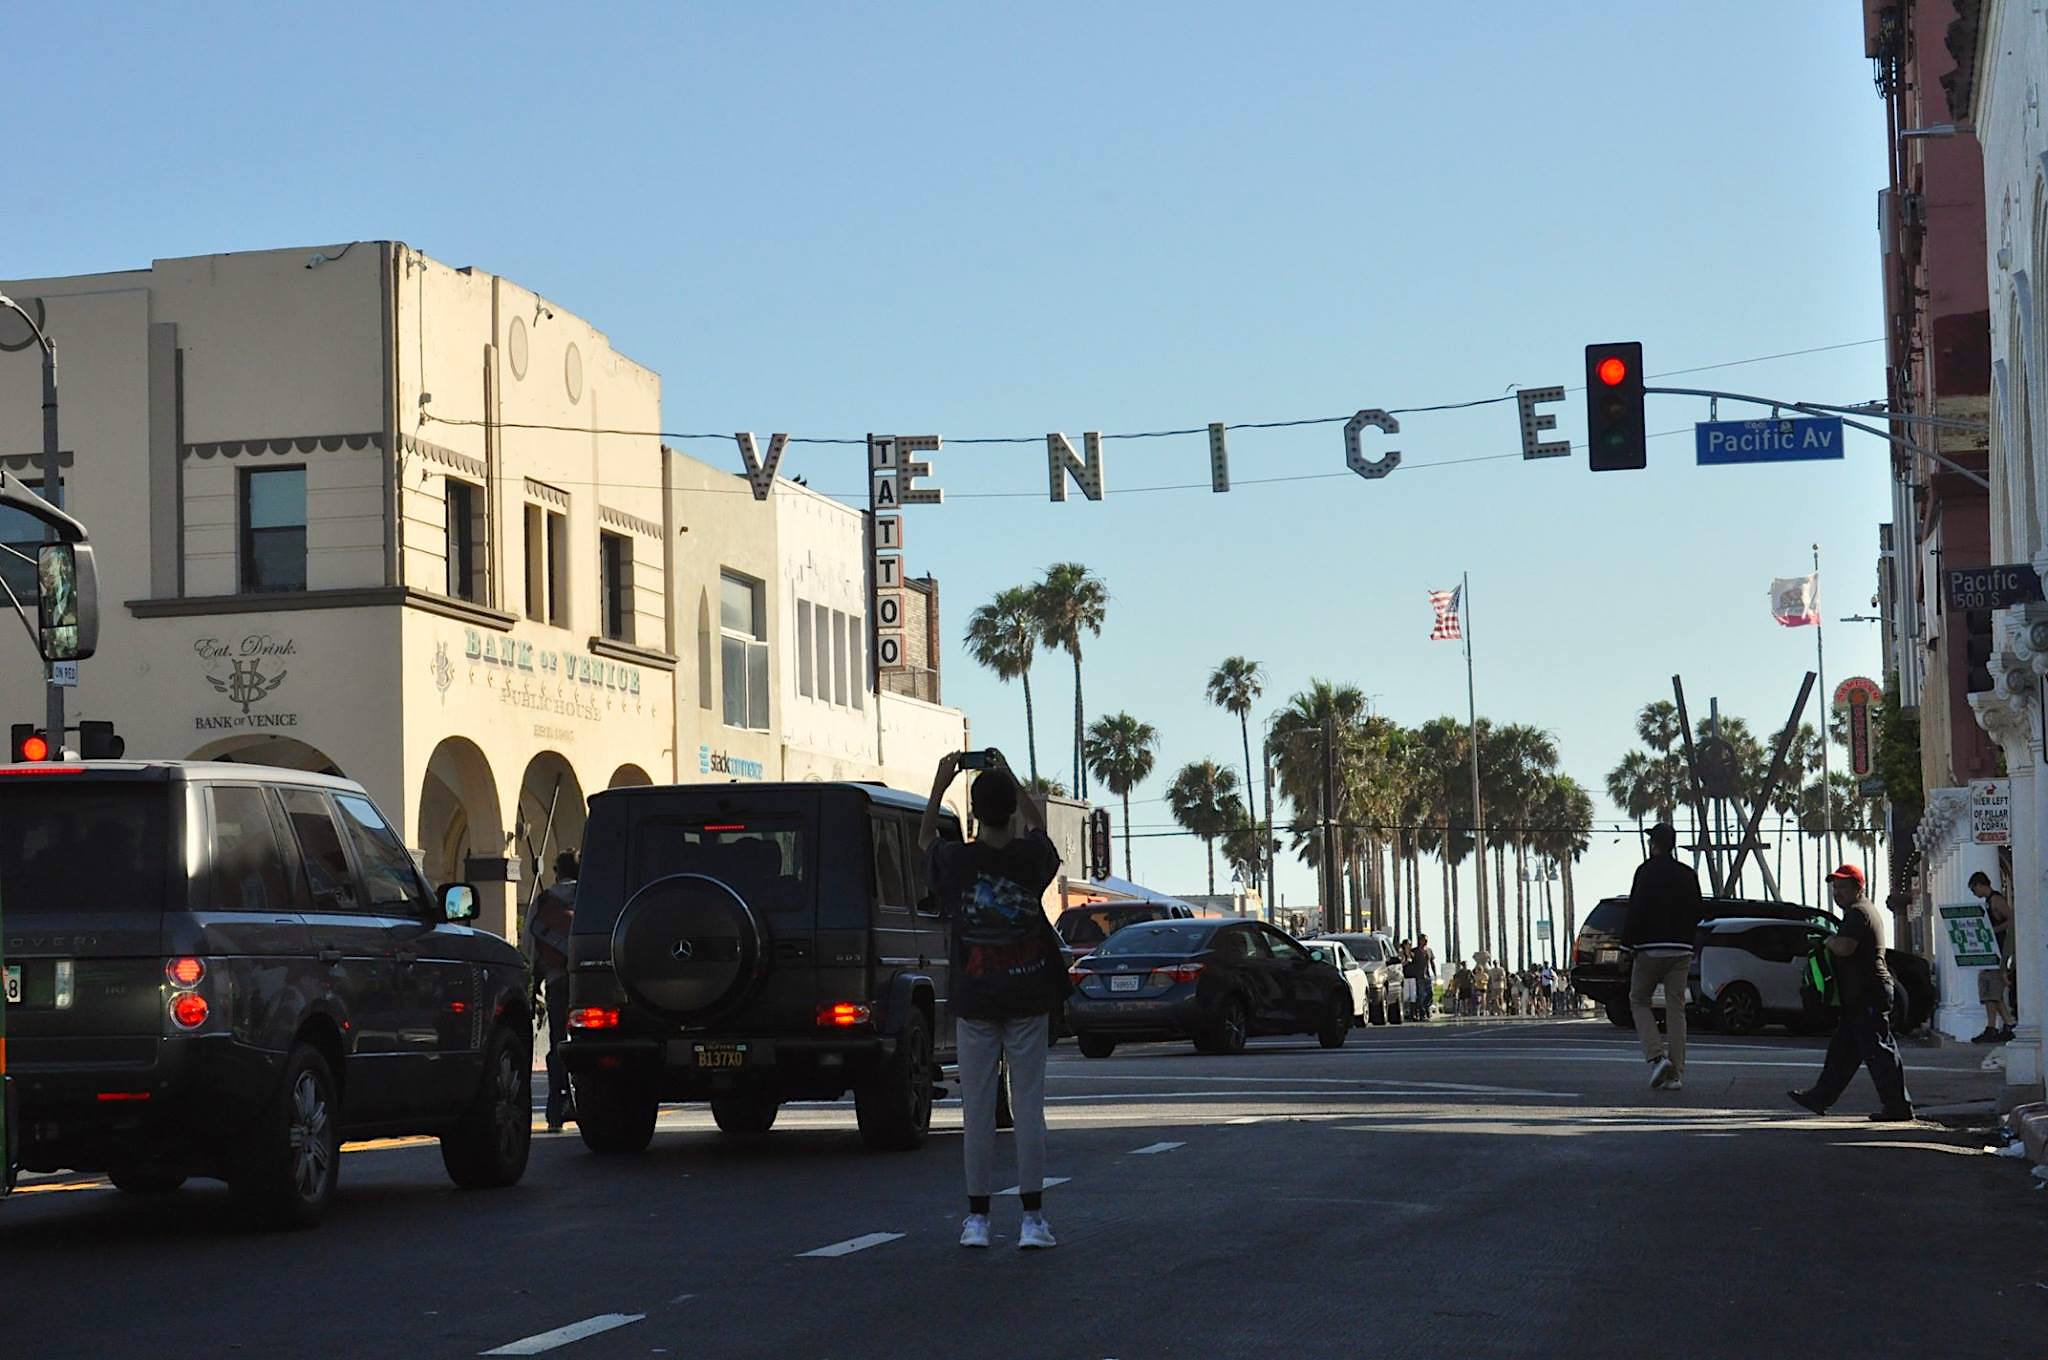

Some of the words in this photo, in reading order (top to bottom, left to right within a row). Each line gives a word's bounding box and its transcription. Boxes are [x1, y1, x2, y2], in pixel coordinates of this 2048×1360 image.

[735, 386, 1571, 504] VENICE
[1709, 428, 1794, 453] Pacific
[1802, 427, 1832, 449] Av
[875, 439, 898, 664] TATTOO
[1951, 569, 2018, 593] Pacific
[1991, 591, 2000, 608] S
[194, 638, 232, 660] Eat.
[240, 634, 297, 657] Drink.
[465, 627, 534, 673] BANK
[563, 650, 640, 696] VENICE
[194, 716, 233, 730] BANK
[246, 713, 298, 728] VENICE
[553, 697, 602, 722] HOUSE
[1991, 796, 2009, 806] LEFT
